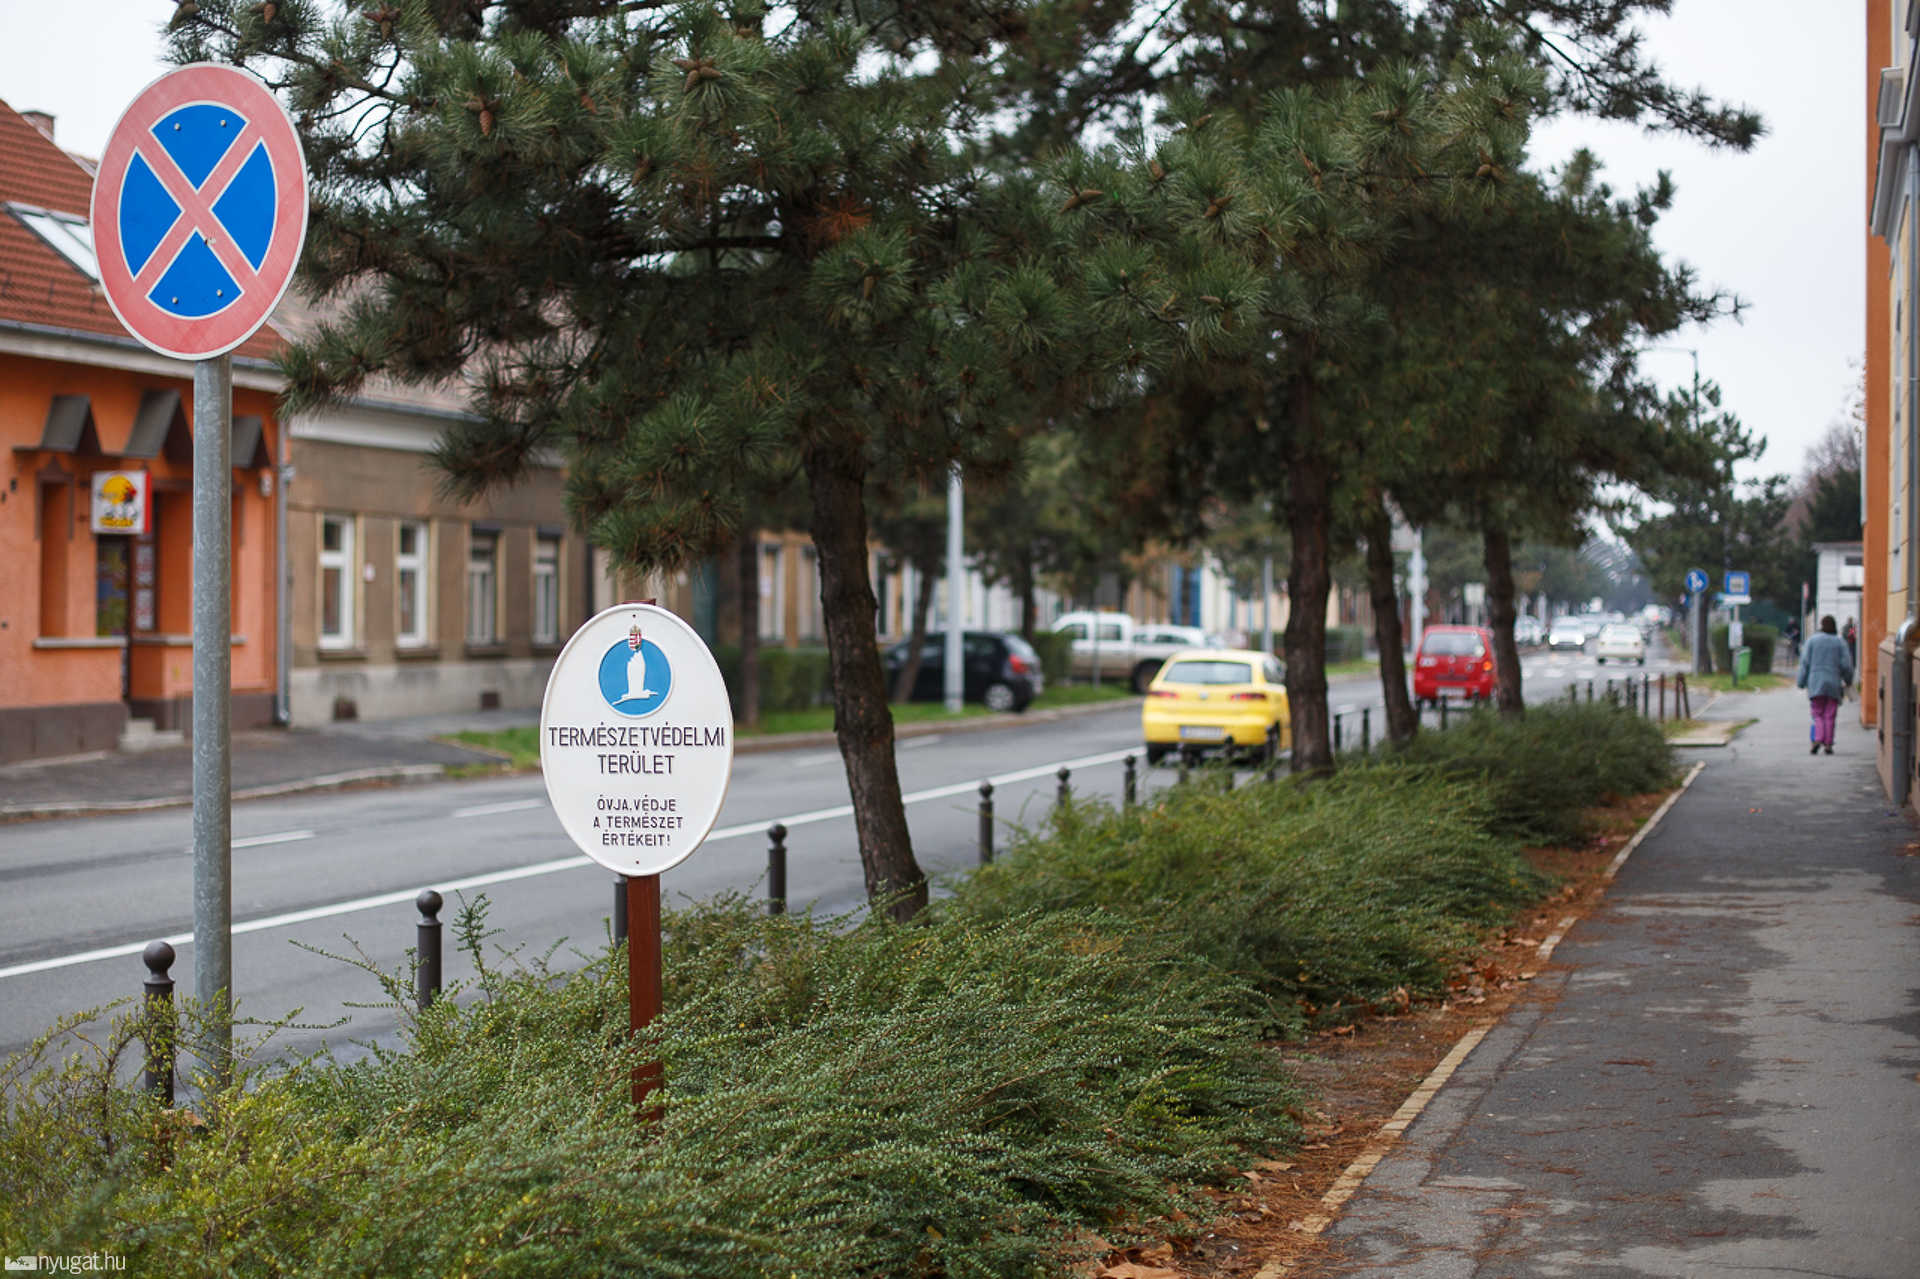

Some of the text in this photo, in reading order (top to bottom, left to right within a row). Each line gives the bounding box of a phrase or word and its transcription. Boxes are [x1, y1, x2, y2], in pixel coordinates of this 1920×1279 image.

[549, 721, 725, 746] TERMÉSZETVÉDELMI
[597, 751, 675, 774] TERÜLET
[593, 812, 683, 828] A TERMÉSZET
[602, 829, 671, 846] ÉRTÉKEIT!
